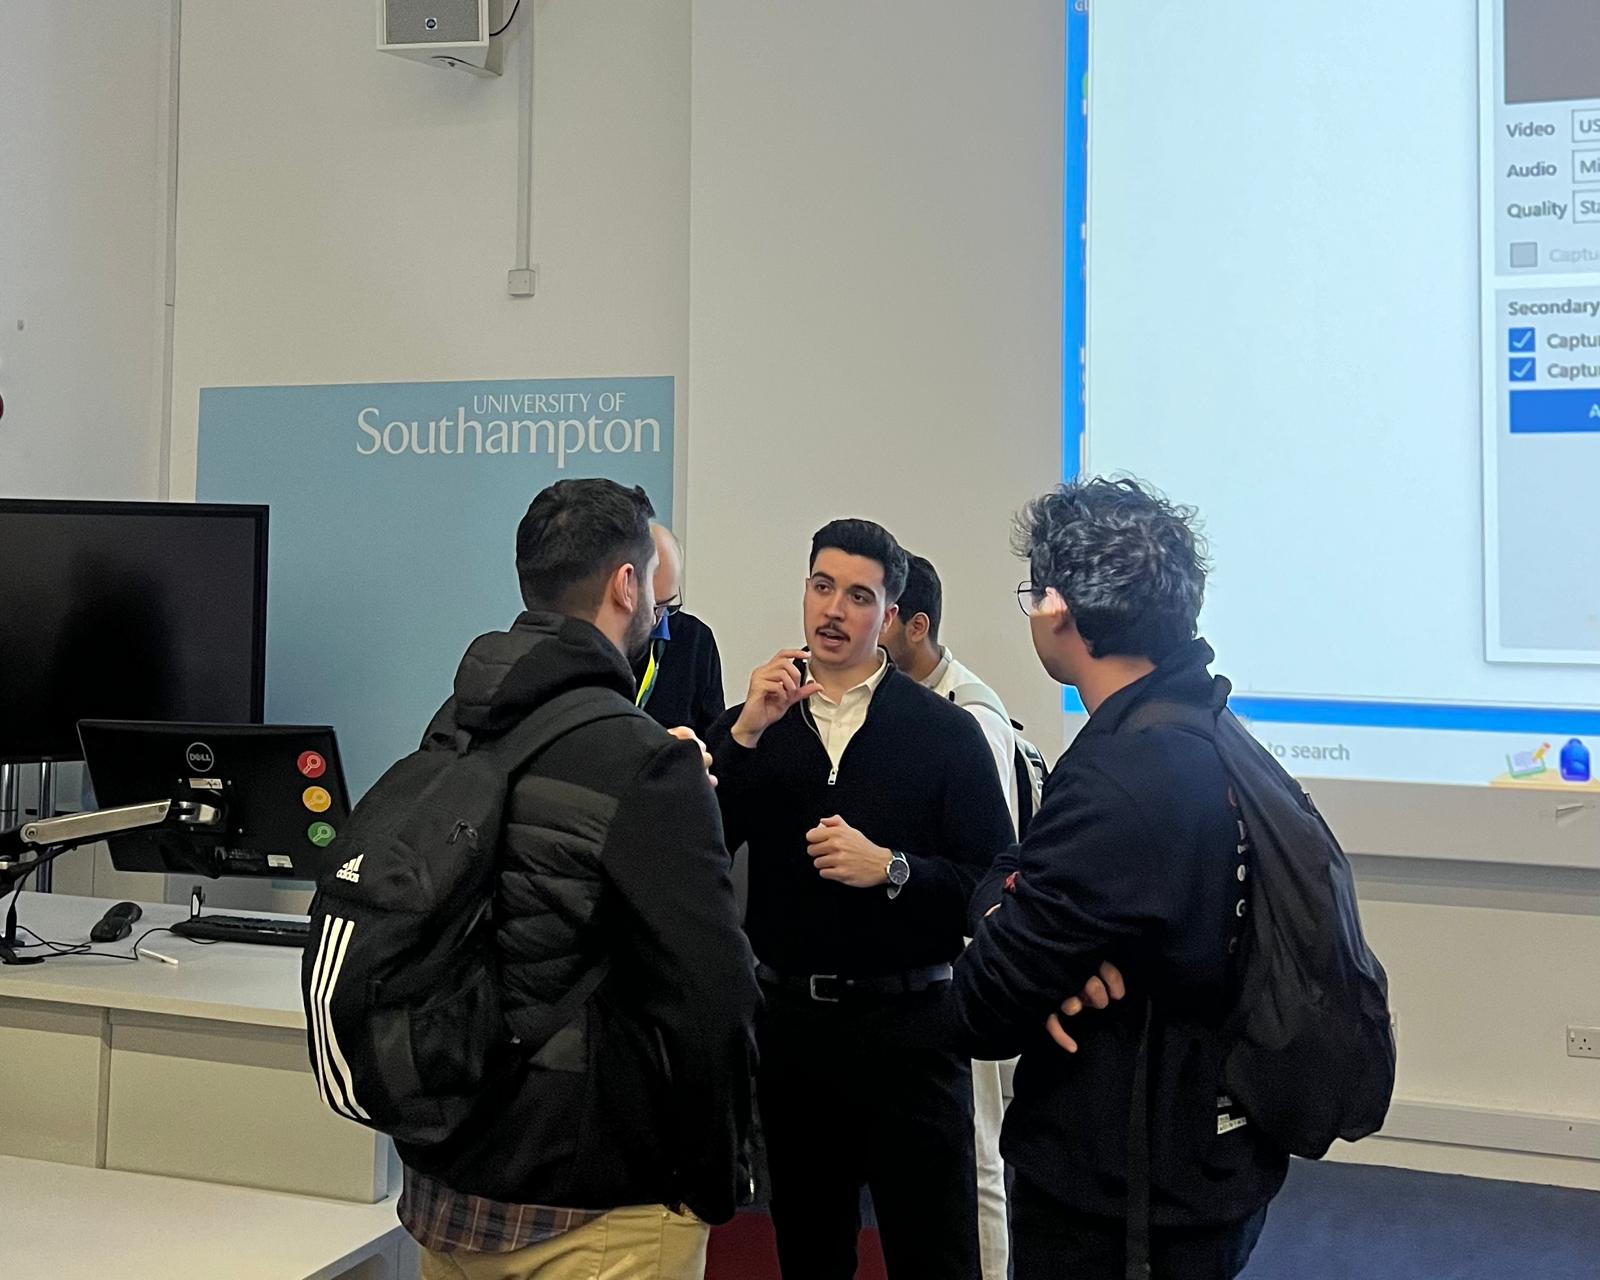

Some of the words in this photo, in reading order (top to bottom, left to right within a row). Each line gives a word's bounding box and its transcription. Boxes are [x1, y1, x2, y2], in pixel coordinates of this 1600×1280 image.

[1506, 121, 1555, 138] Video
[1507, 161, 1557, 178] Audio
[1507, 200, 1567, 220] Quality
[1508, 298, 1600, 318] Secondary
[472, 393, 592, 415] UNIVERSITY
[598, 391, 627, 413] OF
[355, 406, 662, 469] Southampton
[189, 753, 212, 761] DELL
[1290, 743, 1351, 761] search
